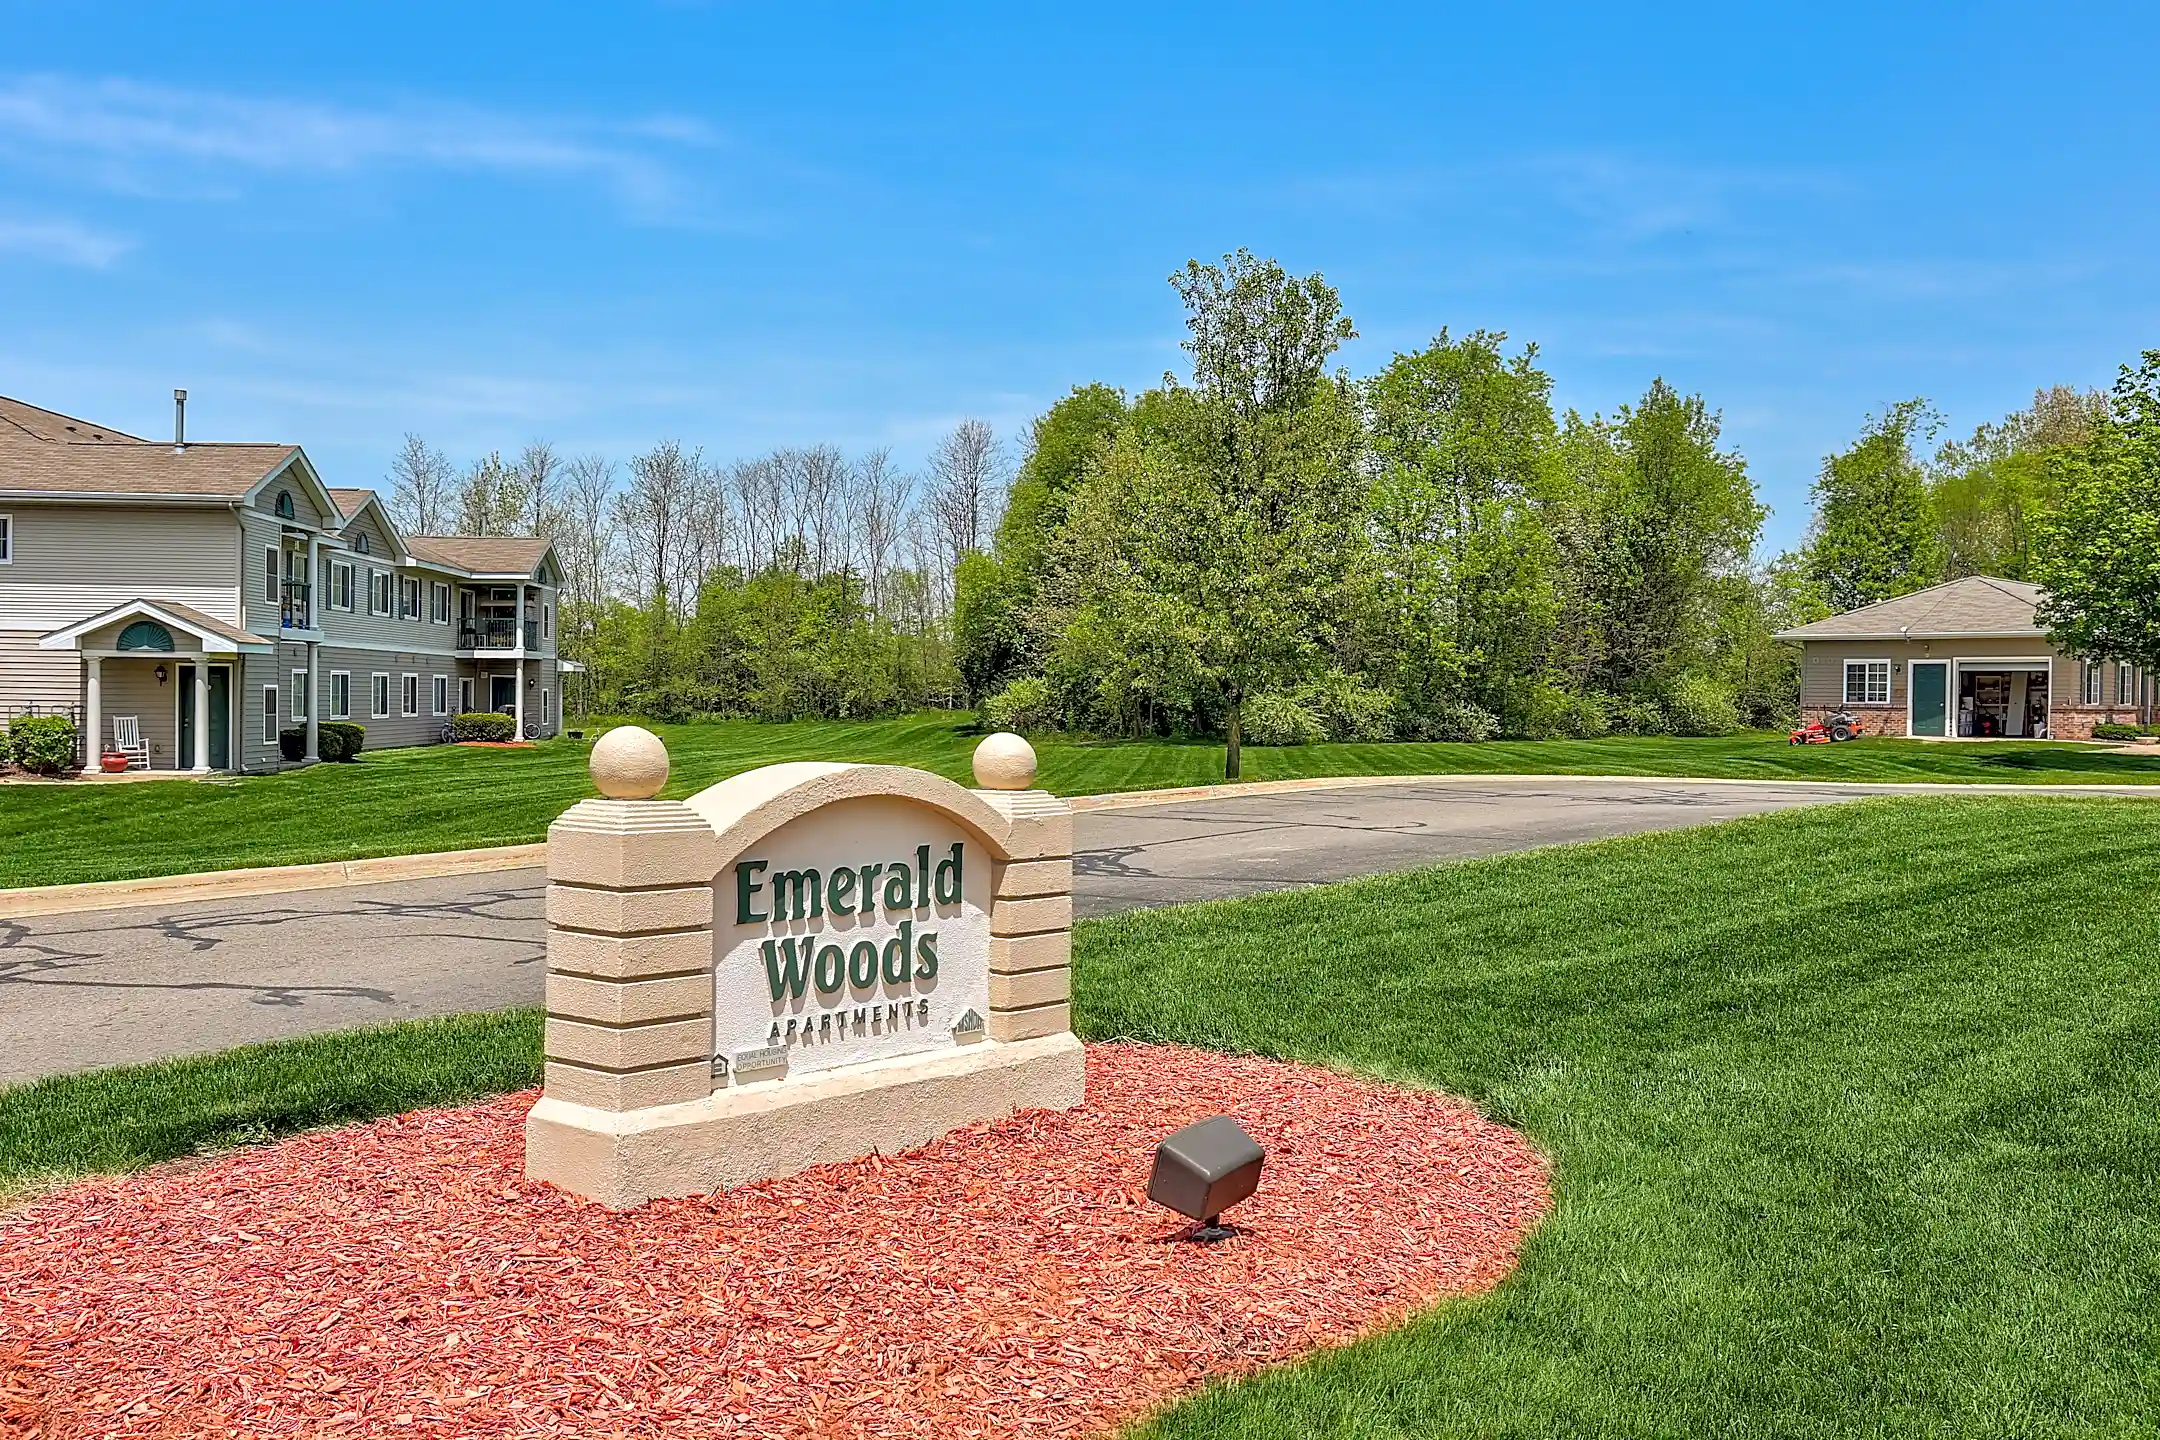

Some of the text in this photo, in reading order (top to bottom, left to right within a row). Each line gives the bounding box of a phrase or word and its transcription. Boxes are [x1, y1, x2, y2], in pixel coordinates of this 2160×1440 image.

[734, 842, 965, 926] Emerald
[761, 920, 939, 1002] Woods
[769, 998, 929, 1039] APARTMENTS
[736, 1057, 787, 1071] OPPORTUNITY
[737, 1046, 787, 1061] EQUAL HOUSING
